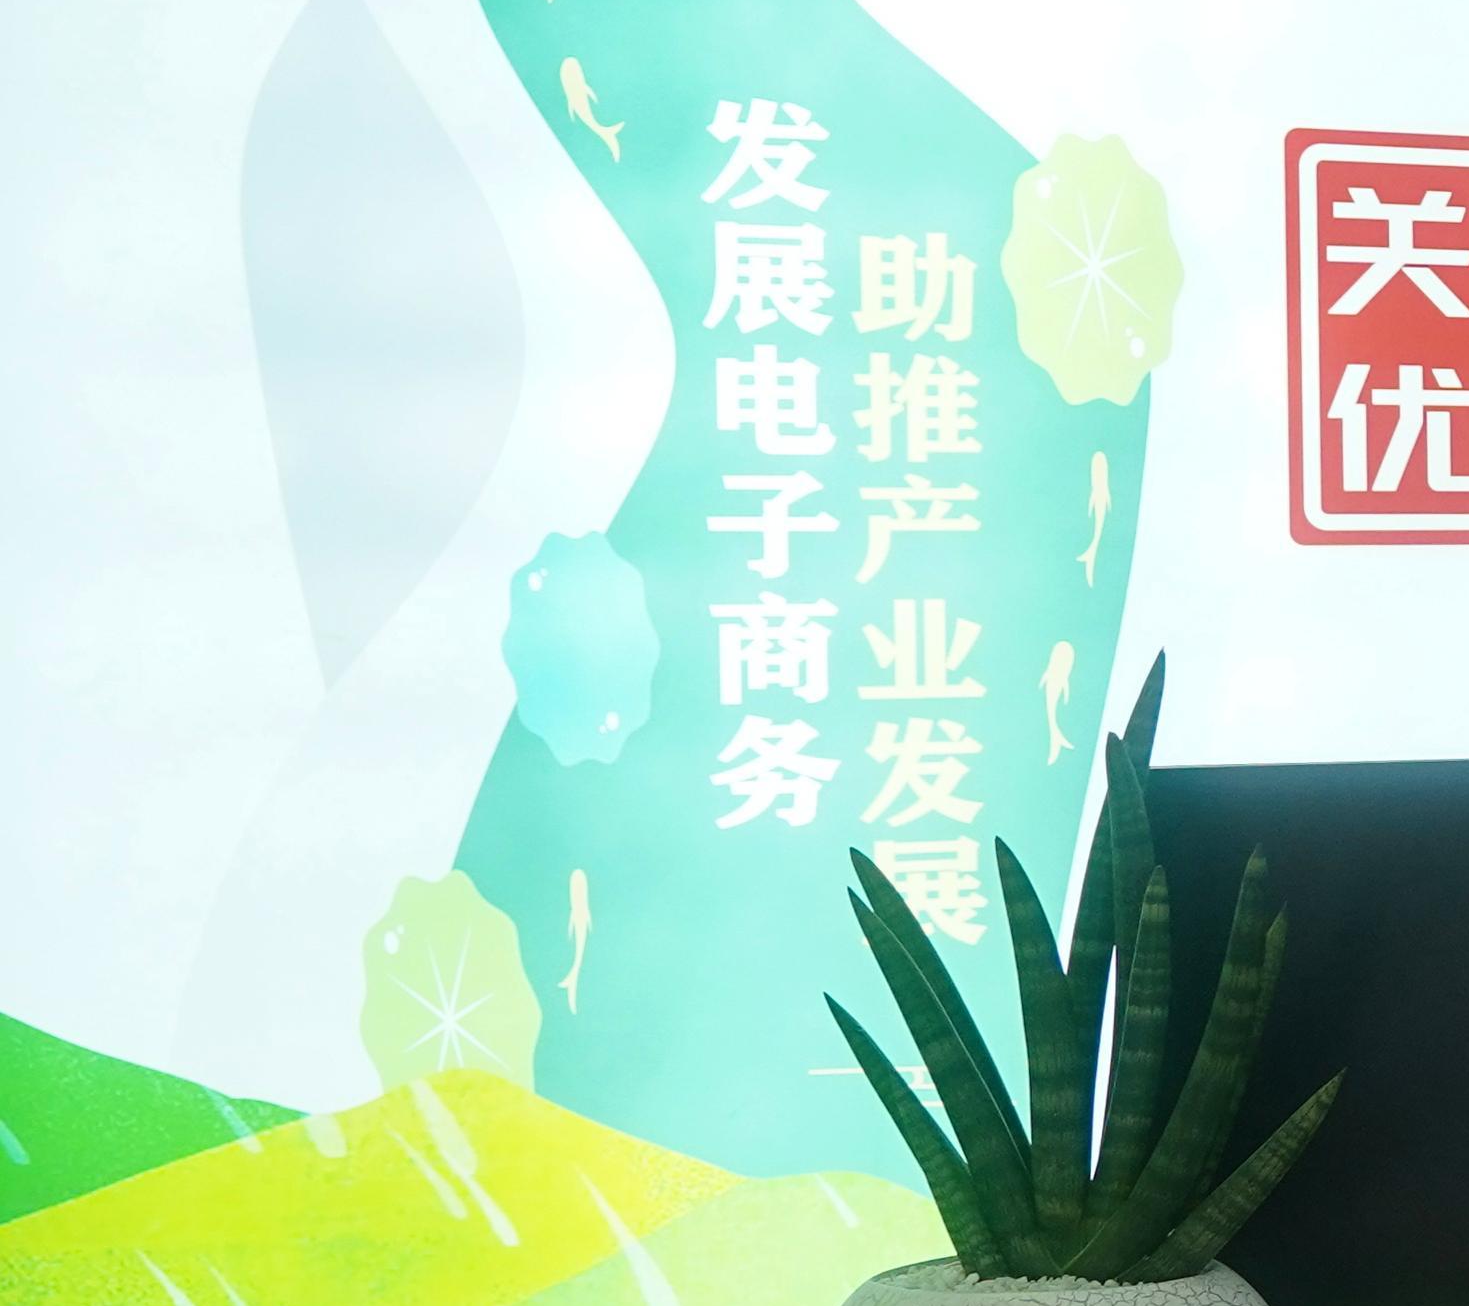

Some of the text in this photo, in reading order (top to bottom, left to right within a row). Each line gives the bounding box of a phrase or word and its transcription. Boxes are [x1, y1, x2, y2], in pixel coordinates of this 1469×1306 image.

[702, 96, 842, 831] 发展电子商务
[851, 231, 988, 948] 助推产业发展
